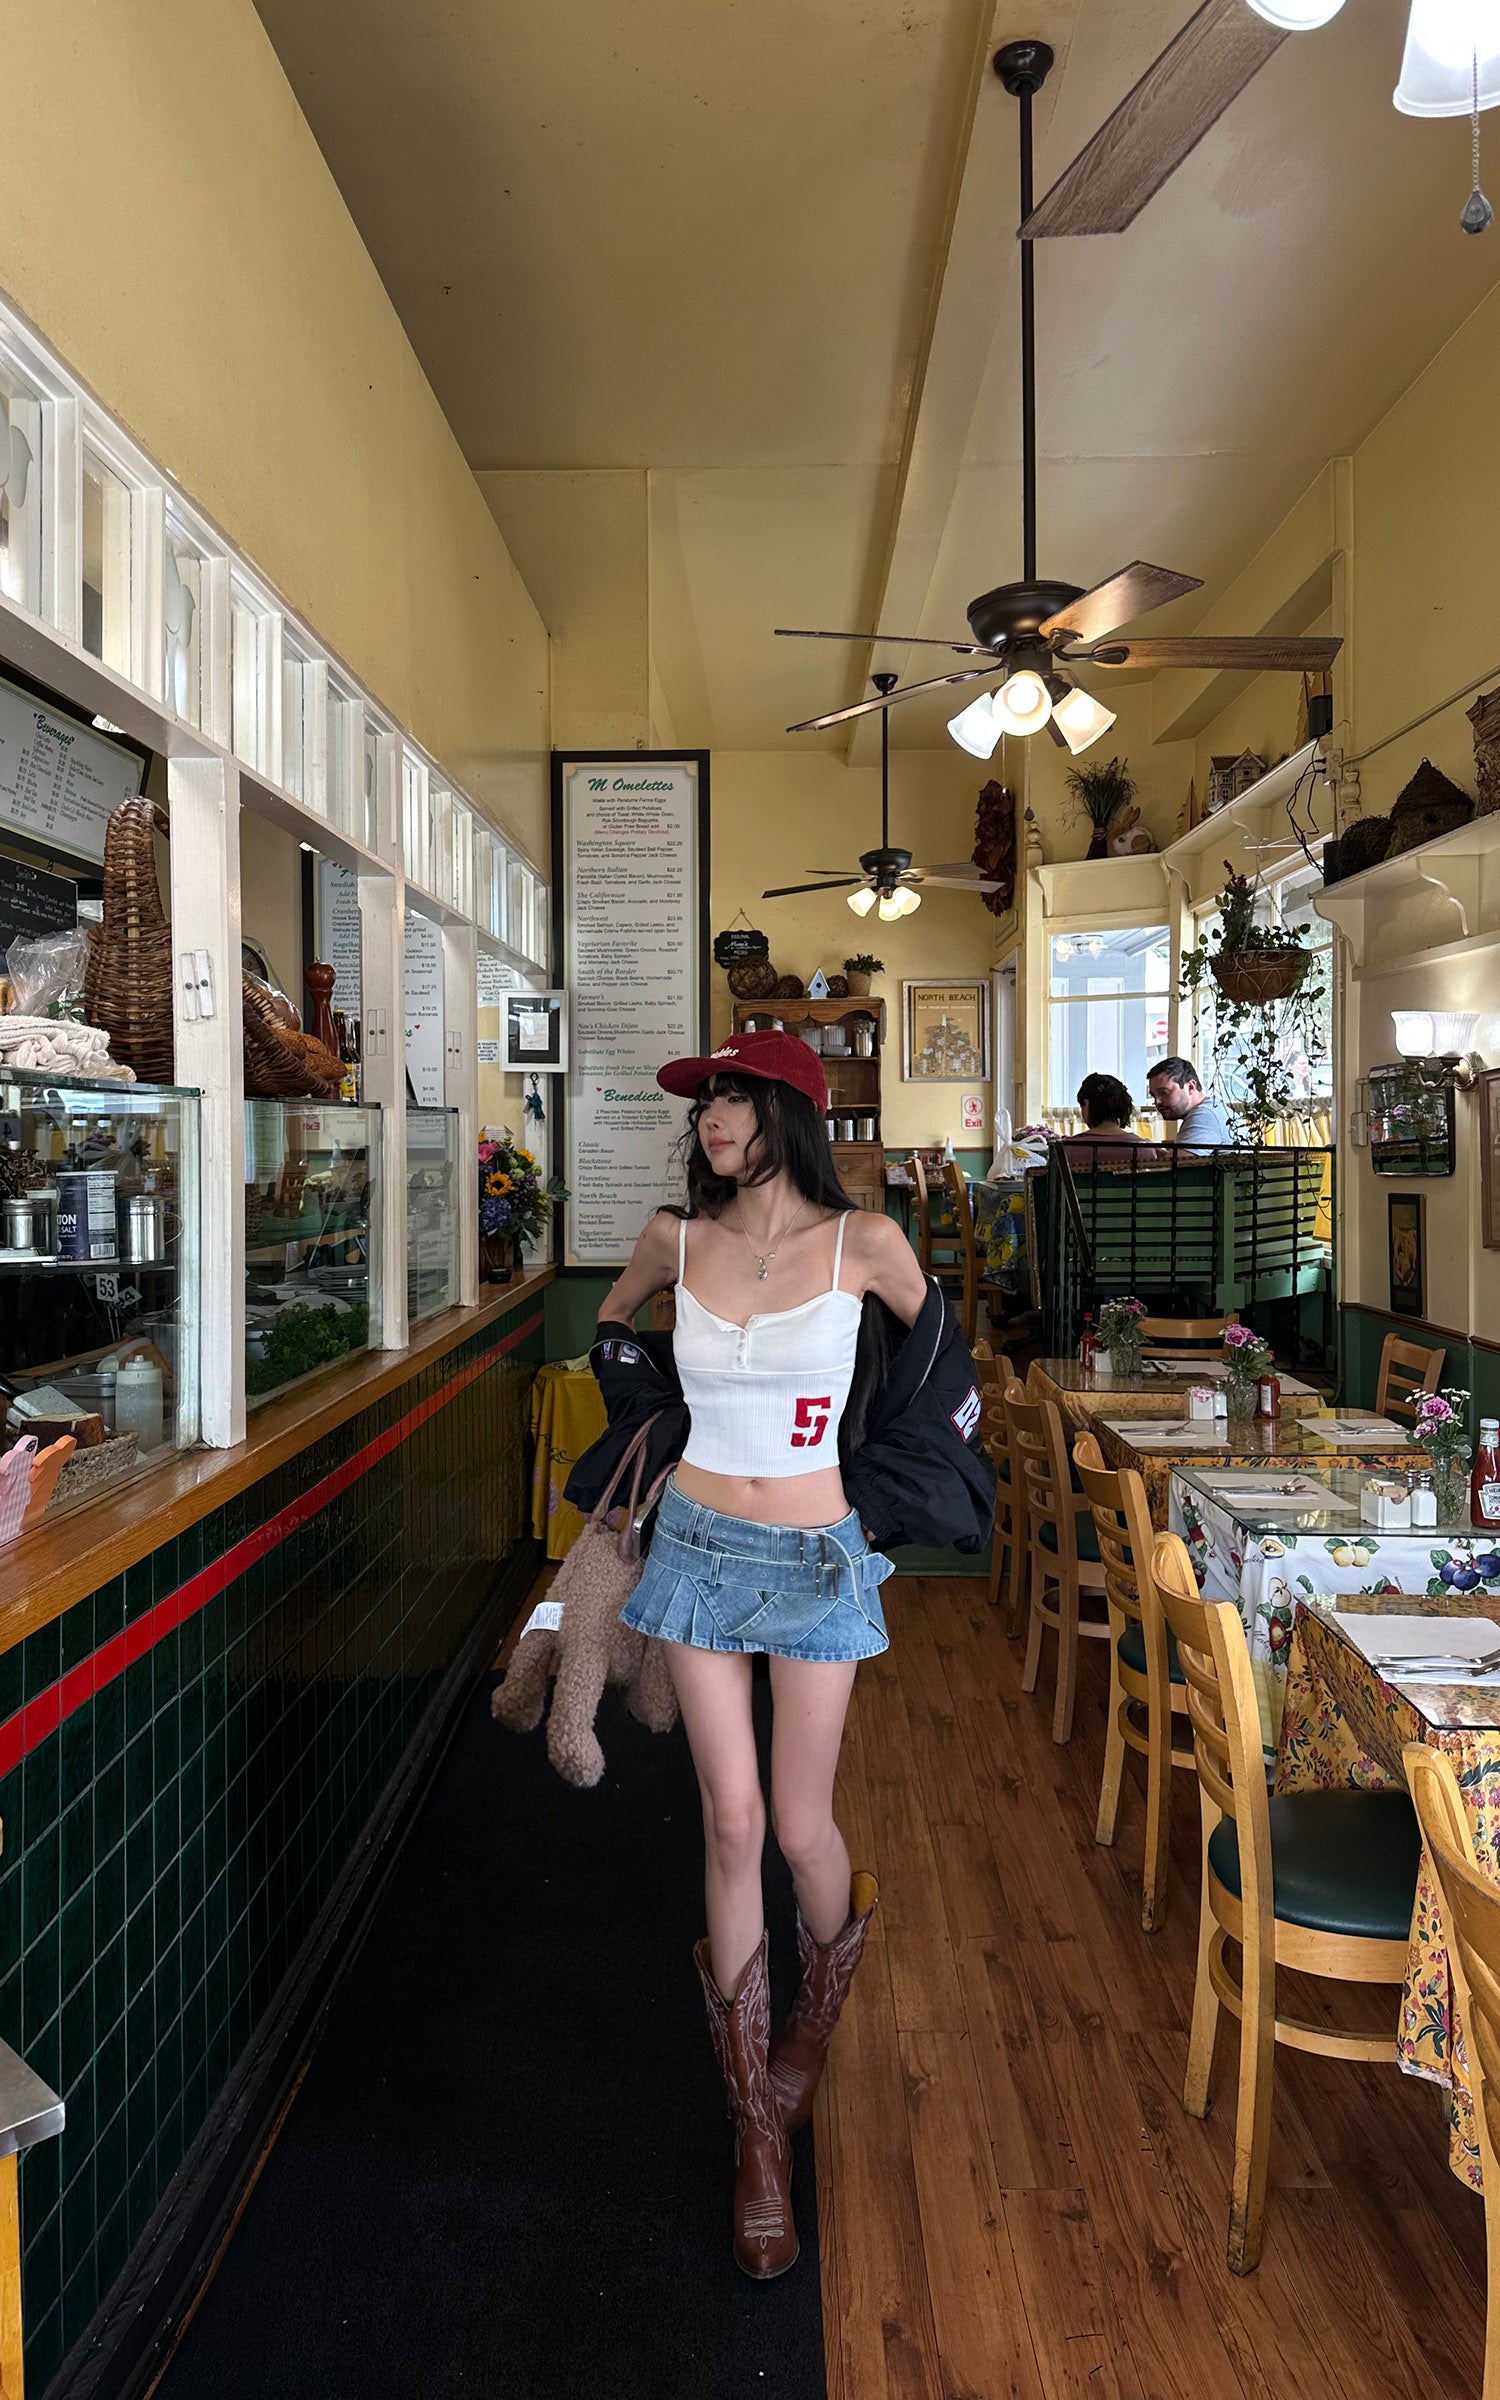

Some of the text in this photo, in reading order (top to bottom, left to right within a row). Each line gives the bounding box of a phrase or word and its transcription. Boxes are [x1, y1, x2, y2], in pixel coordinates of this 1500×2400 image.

[37, 714, 72, 745] Beverages
[588, 778, 674, 791] M Omelettes
[604, 1089, 664, 1102] Benedicts
[965, 1119, 982, 1128] Exit
[99, 1278, 115, 1296] 53
